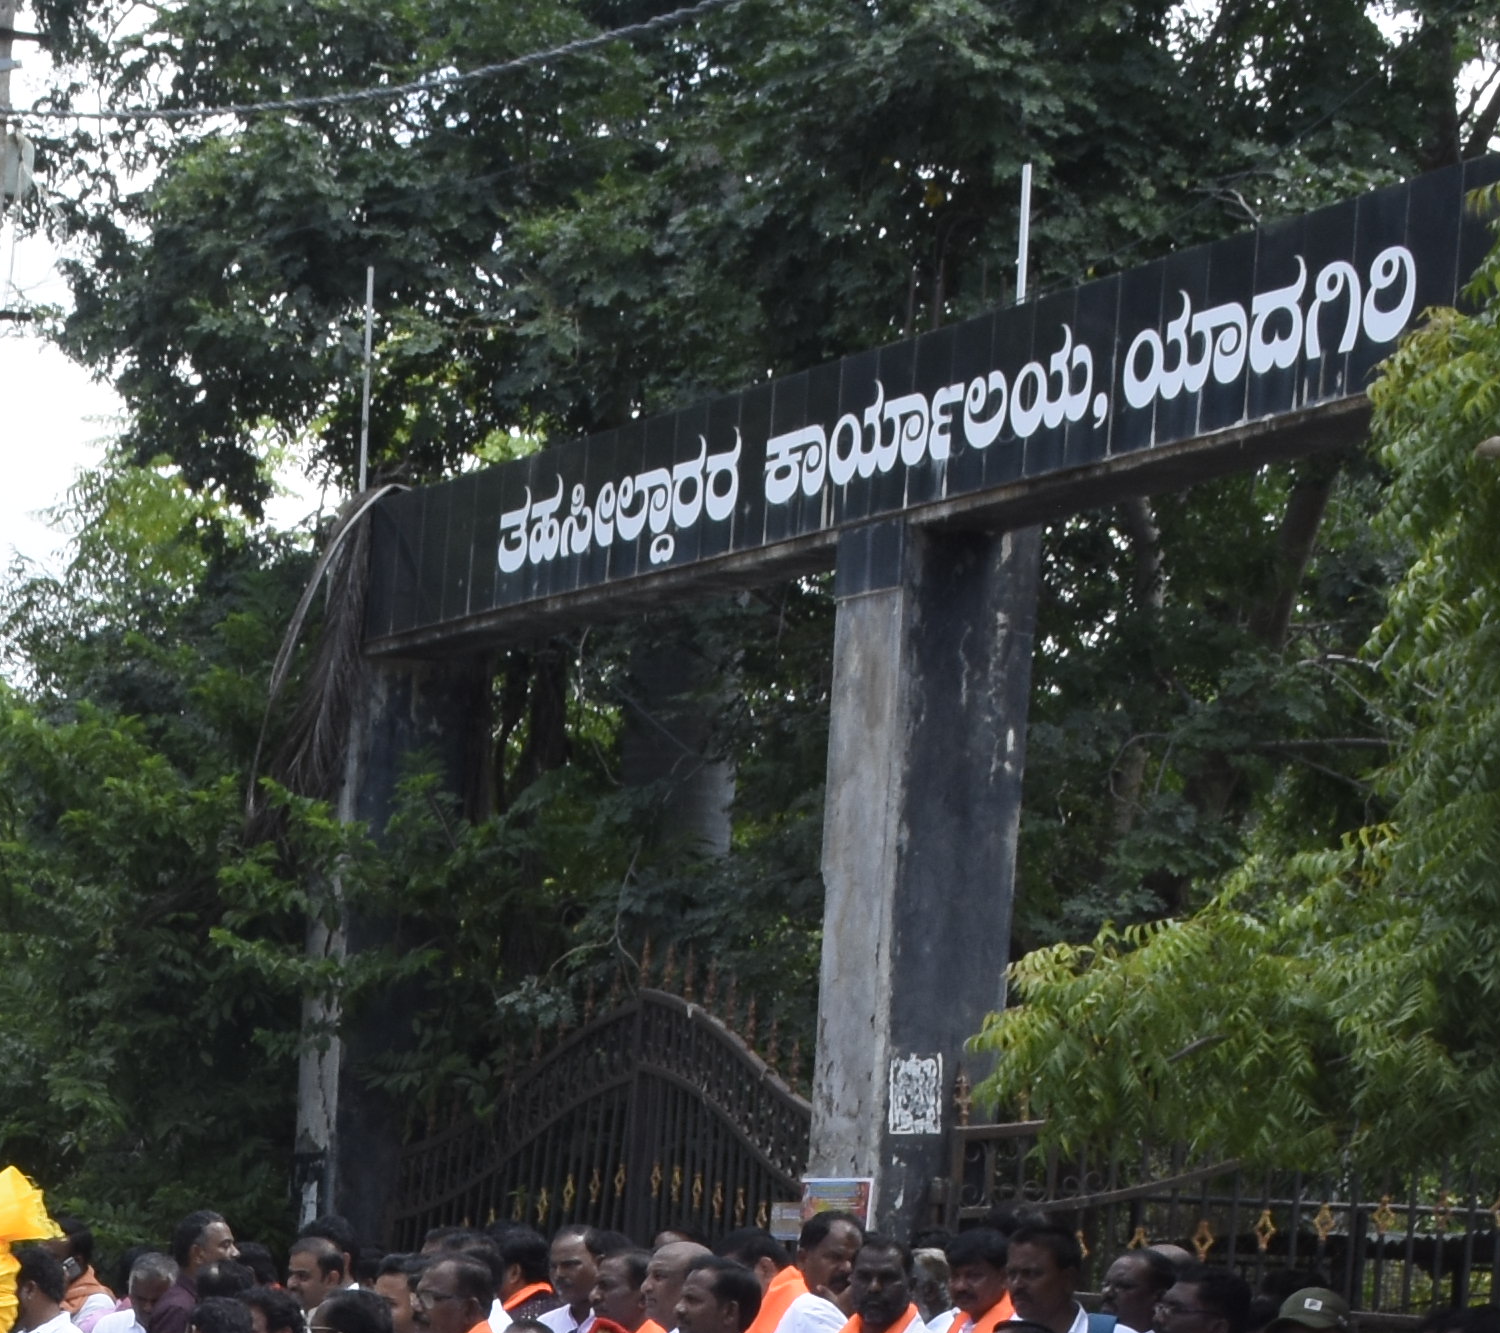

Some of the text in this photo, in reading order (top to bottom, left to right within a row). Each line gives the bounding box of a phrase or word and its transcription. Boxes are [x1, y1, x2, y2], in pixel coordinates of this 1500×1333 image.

[498, 245, 1417, 574] ತಹಸೀಲ್ದಾರರ ಕಾರ್ಯಾಲಯ, ಯಾದಗಿರಿ
